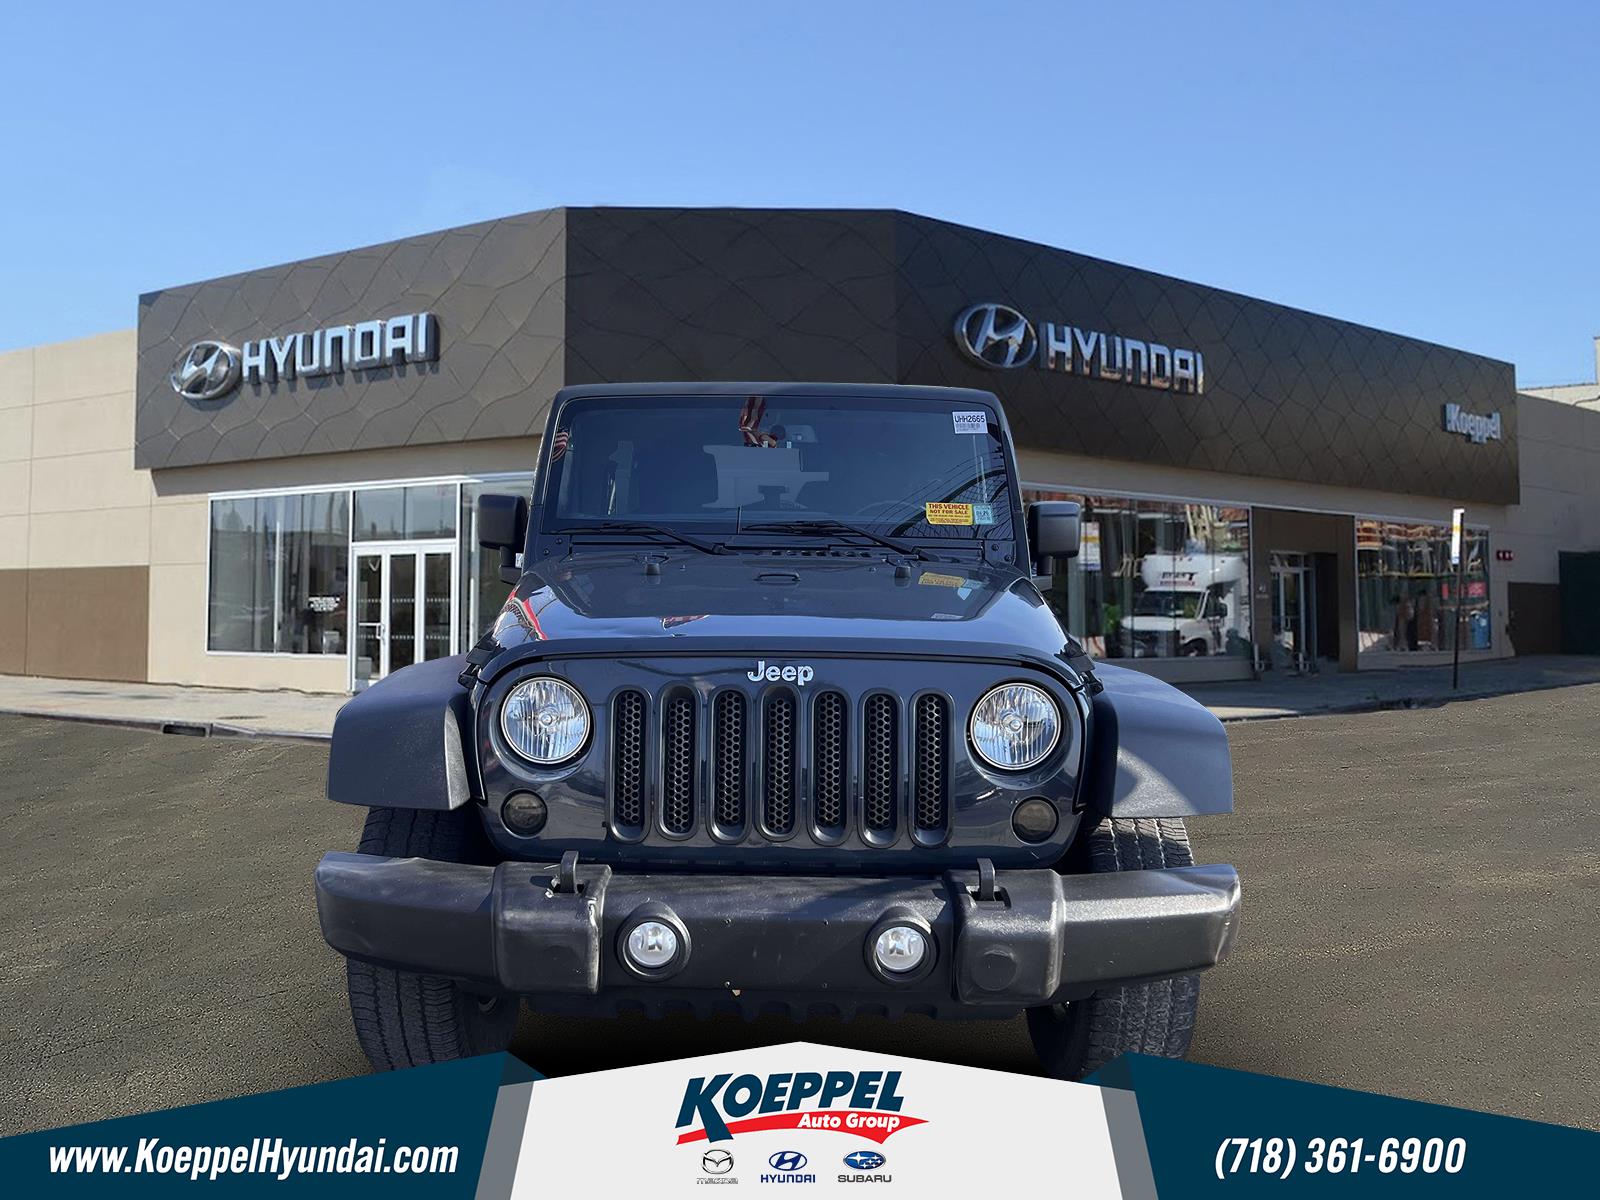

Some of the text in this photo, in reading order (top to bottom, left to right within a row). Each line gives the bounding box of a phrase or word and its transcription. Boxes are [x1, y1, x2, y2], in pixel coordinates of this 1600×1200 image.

[241, 311, 434, 383] HYUNDAI
[1045, 322, 1204, 395] HYUNDAI
[954, 415, 986, 423] UHH2665
[1445, 403, 1501, 444] Koeppel
[747, 660, 814, 686] Jeep
